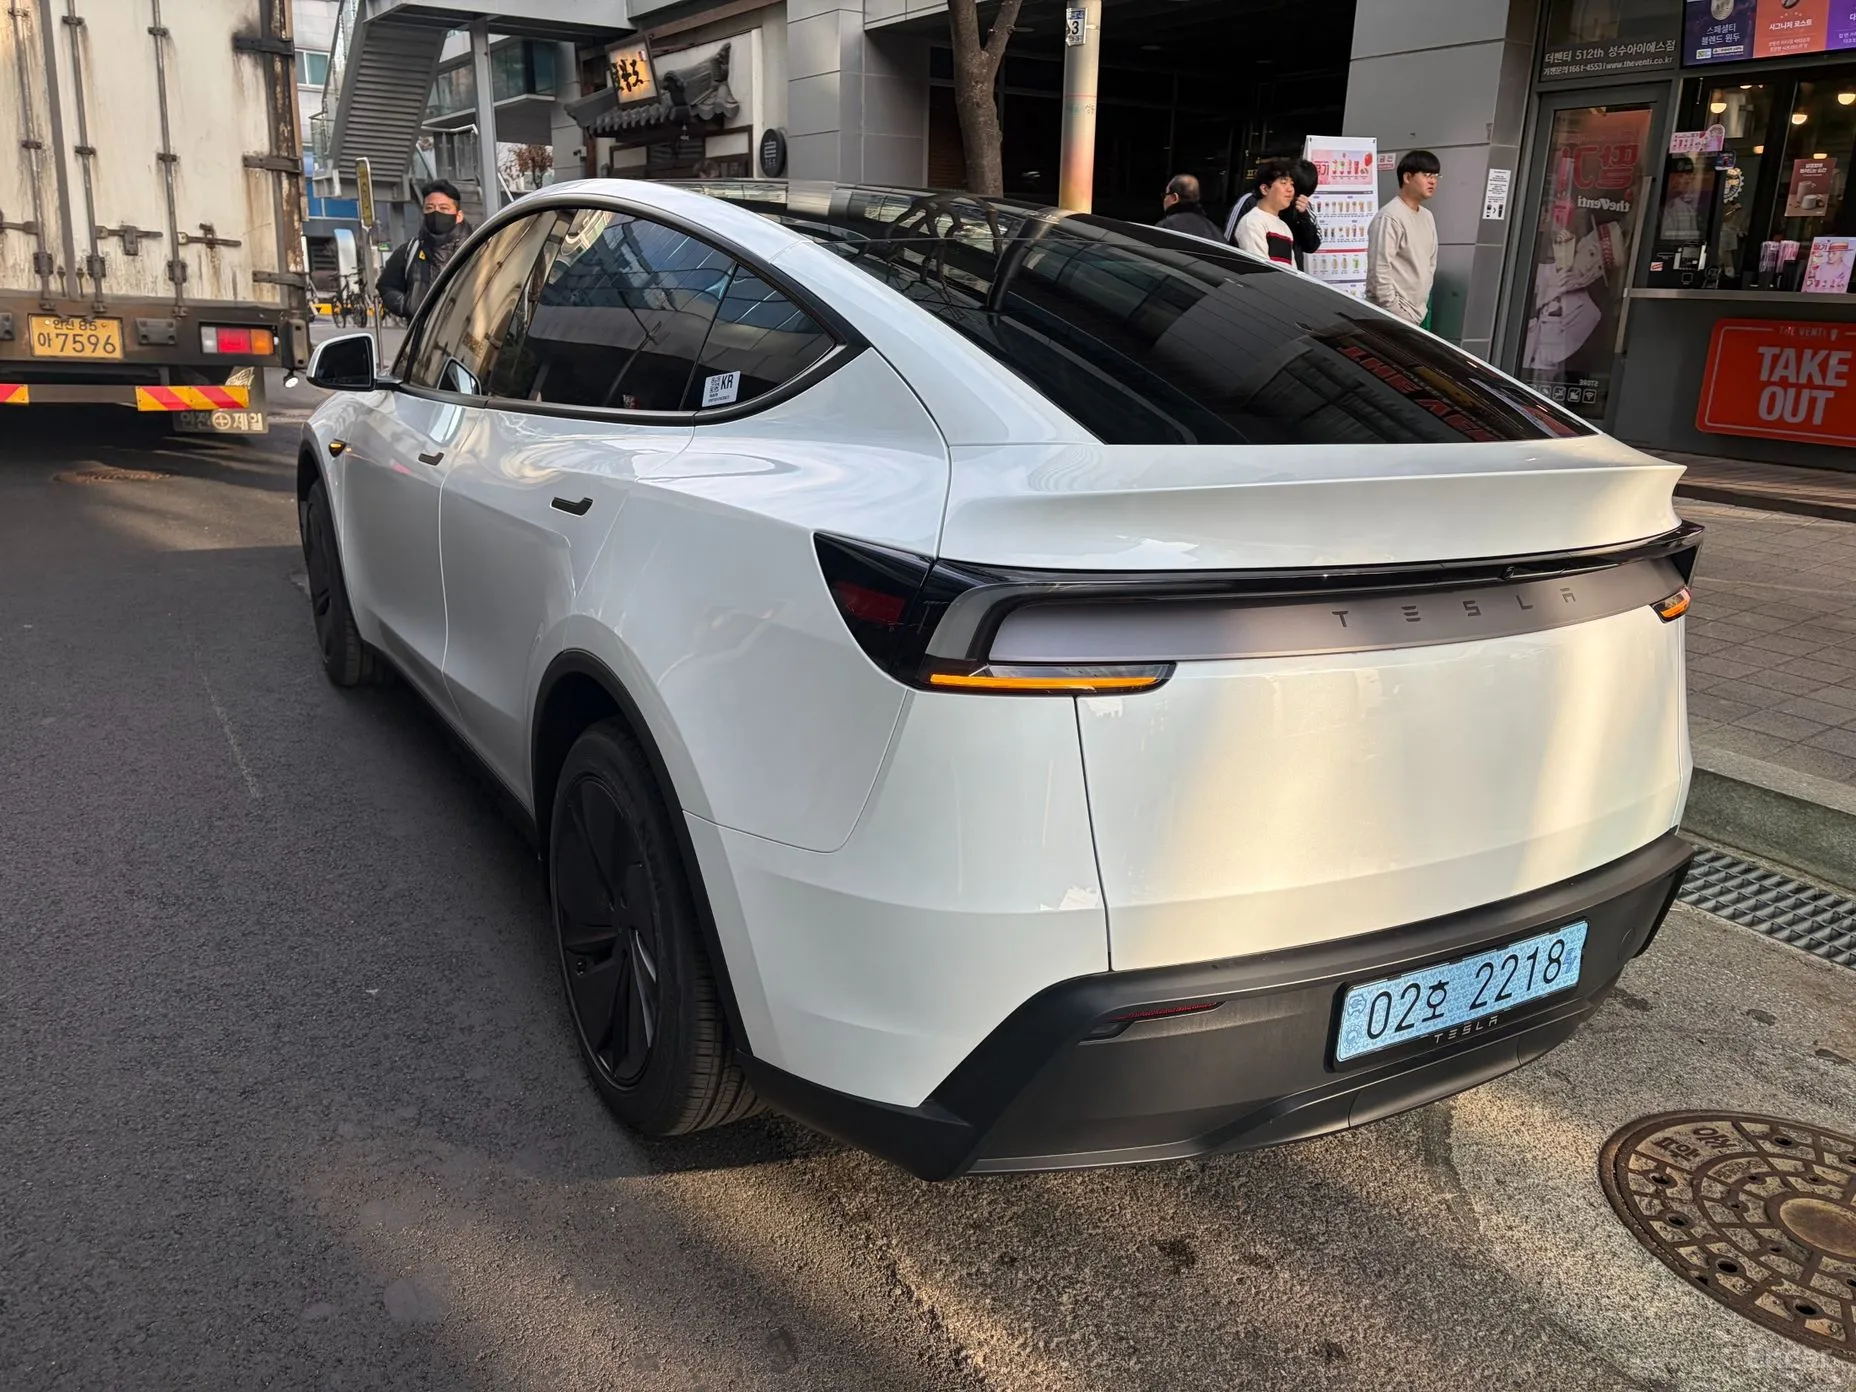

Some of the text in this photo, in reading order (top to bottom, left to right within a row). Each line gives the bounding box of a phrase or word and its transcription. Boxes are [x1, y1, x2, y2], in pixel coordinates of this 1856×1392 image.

[1575, 48, 1604, 61] 512th
[720, 374, 734, 390] KR
[1758, 346, 1852, 387] TAKE
[232, 412, 263, 431] 제일
[1758, 385, 1835, 426] OUT
[1332, 587, 1576, 628] TESLA
[1367, 938, 1565, 1040] 02호 2218
[1434, 1015, 1499, 1044] TESLA
